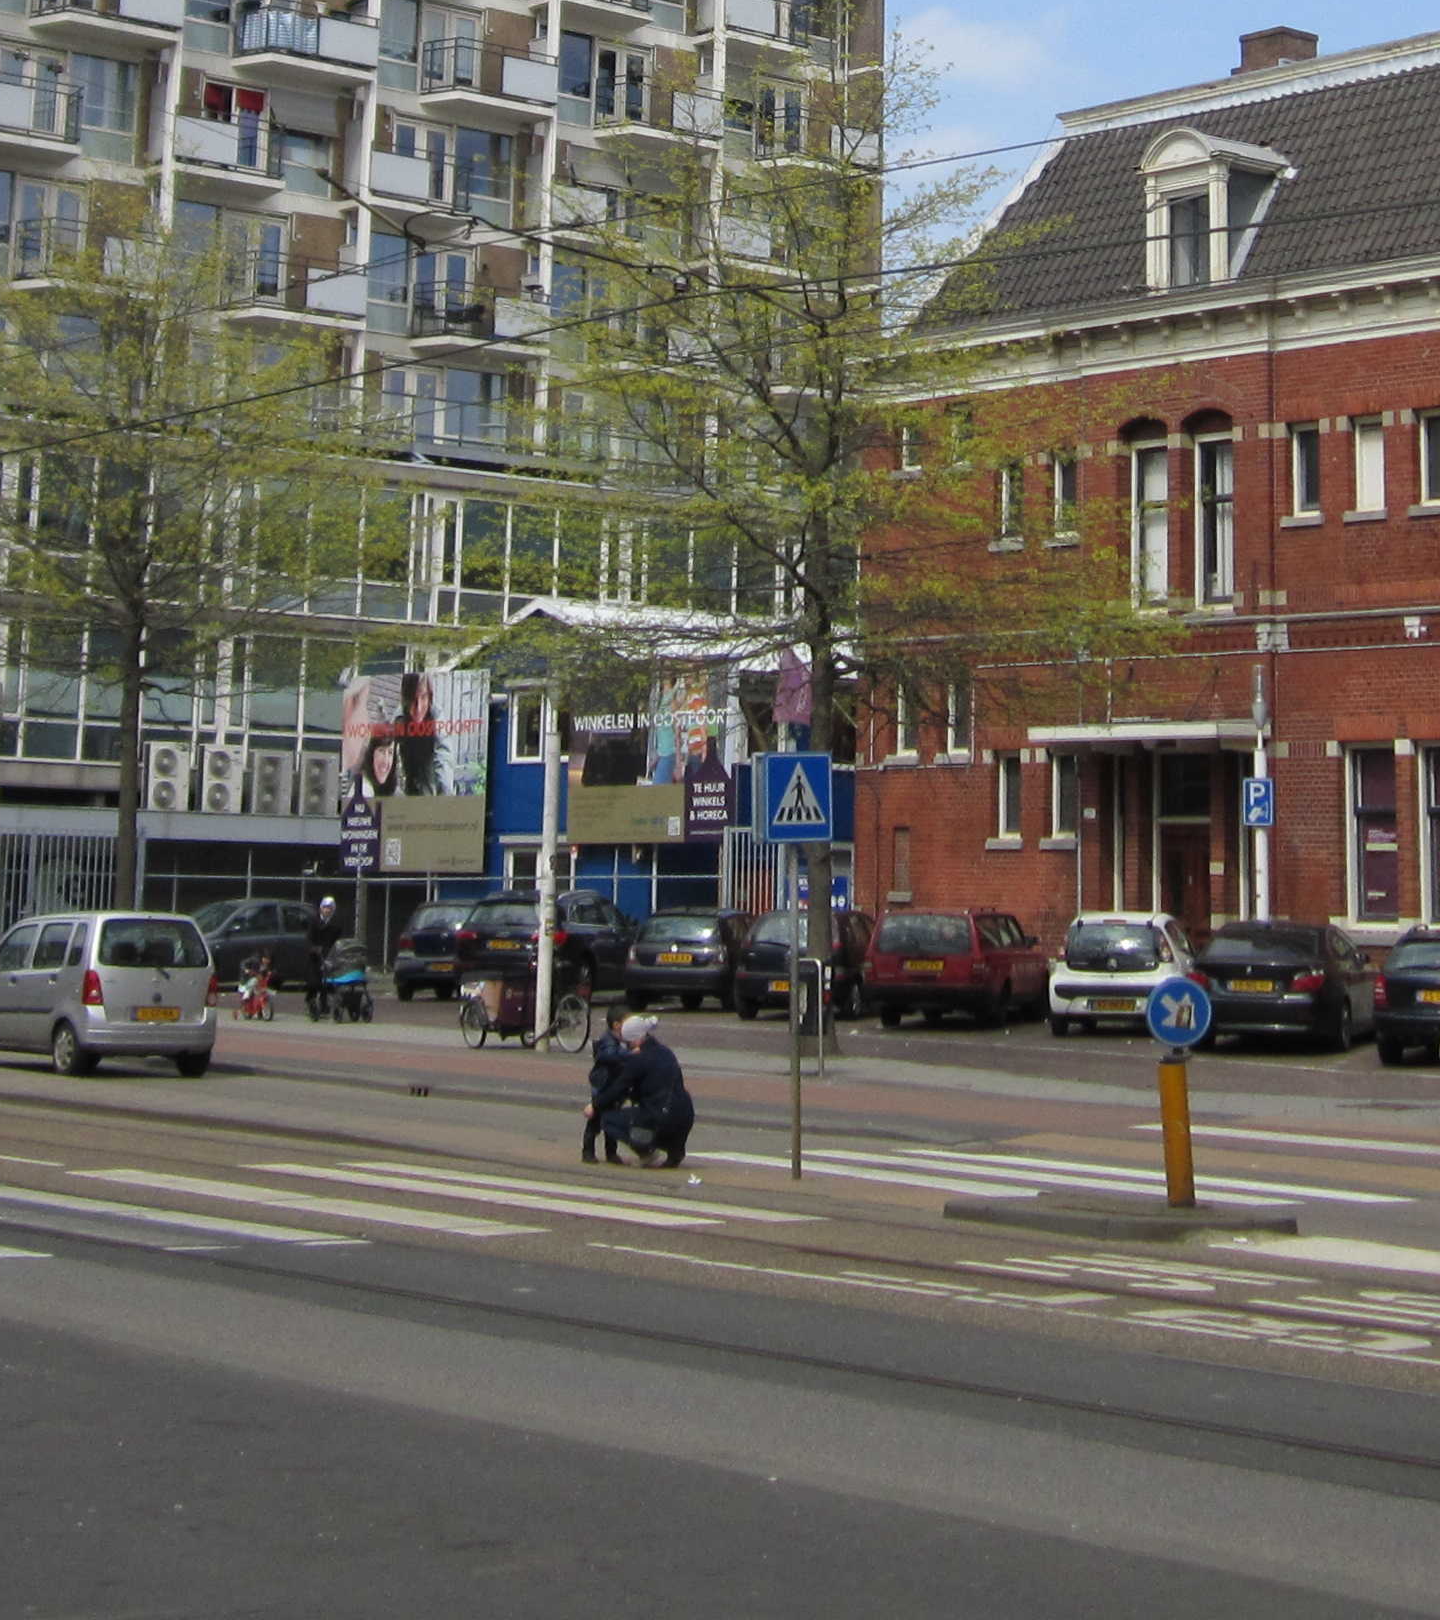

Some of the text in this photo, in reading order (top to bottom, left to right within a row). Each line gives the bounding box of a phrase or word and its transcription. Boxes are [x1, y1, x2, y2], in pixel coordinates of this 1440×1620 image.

[574, 708, 727, 731] WINKELEN IN OOSTPOORT
[693, 782, 725, 793] TE HUUR
[1250, 782, 1265, 806] P
[692, 796, 725, 806] WINKELS
[697, 810, 728, 820] HORECA
